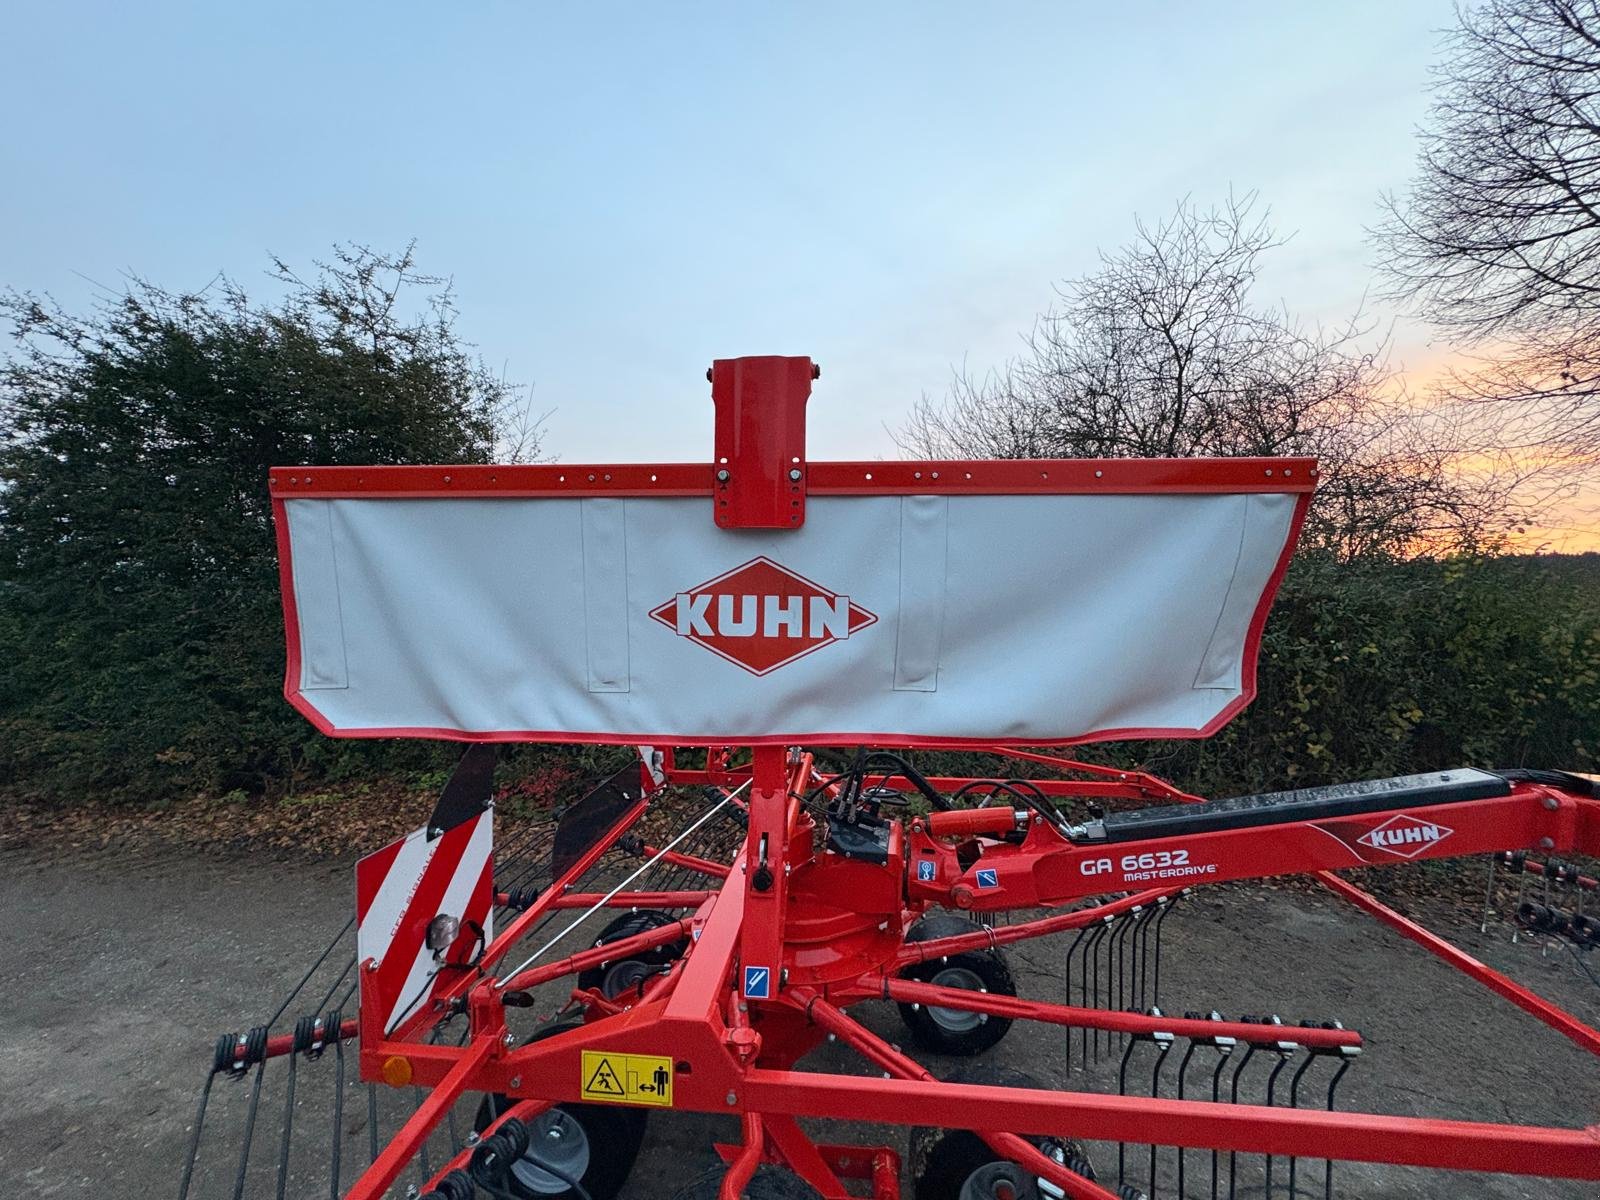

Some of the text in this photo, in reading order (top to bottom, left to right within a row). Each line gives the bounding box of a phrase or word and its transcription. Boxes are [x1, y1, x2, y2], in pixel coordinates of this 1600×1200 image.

[676, 593, 850, 639] KUHN
[1370, 825, 1440, 848] KUHN
[1080, 849, 1190, 876] GA 6632
[1124, 864, 1217, 882] MASTERDRIVE
